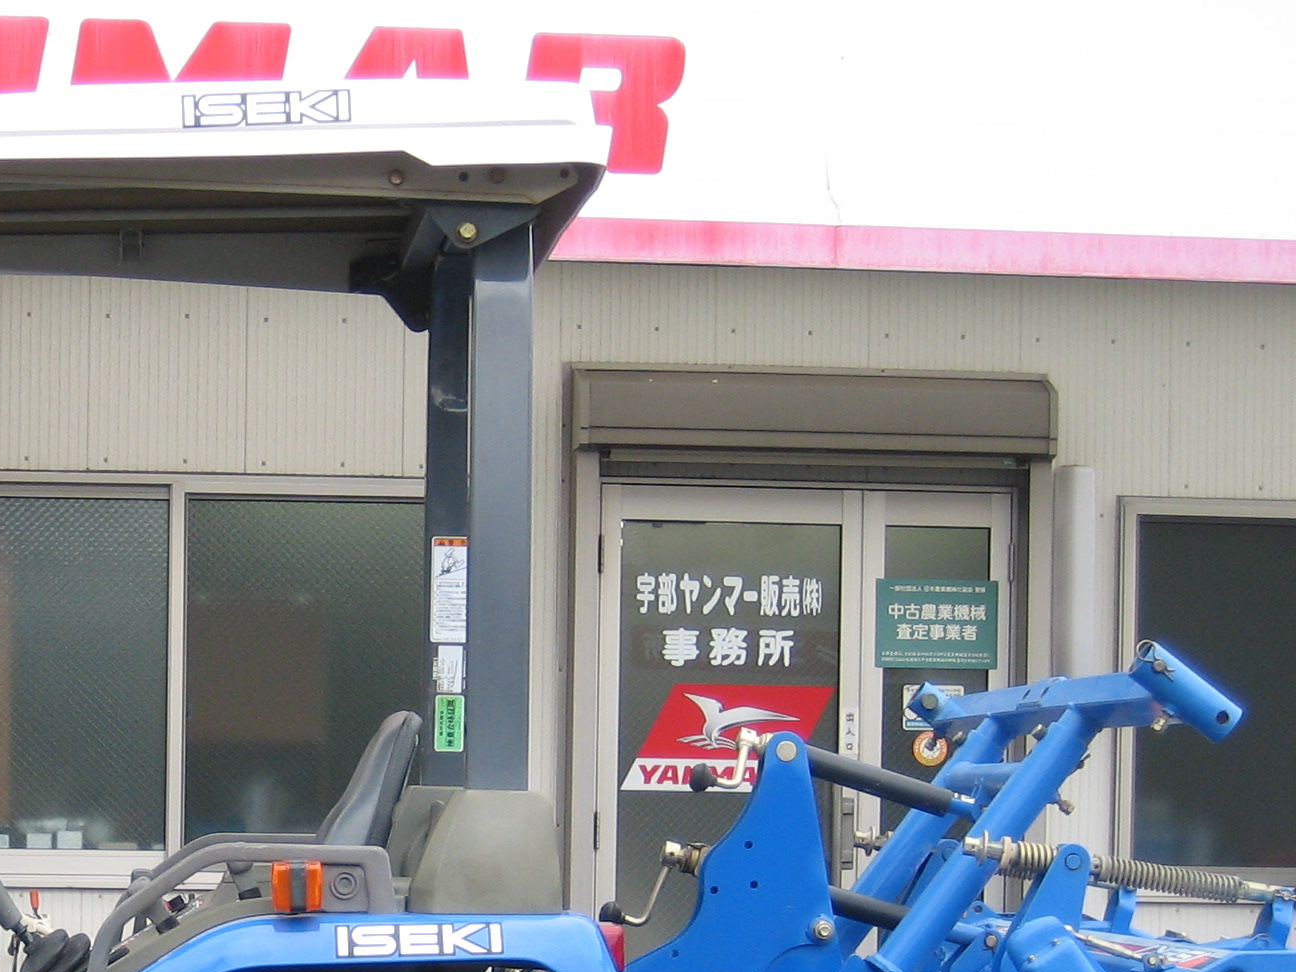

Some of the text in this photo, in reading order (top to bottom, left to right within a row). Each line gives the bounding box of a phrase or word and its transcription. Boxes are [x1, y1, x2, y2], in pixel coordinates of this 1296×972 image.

[181, 89, 352, 129] ISEKI
[888, 602, 987, 621] 中古農業機械
[661, 626, 795, 668] 事務所
[896, 622, 978, 641] 査定事業者
[845, 711, 856, 751] 出入口
[334, 922, 504, 959] ISEKI
